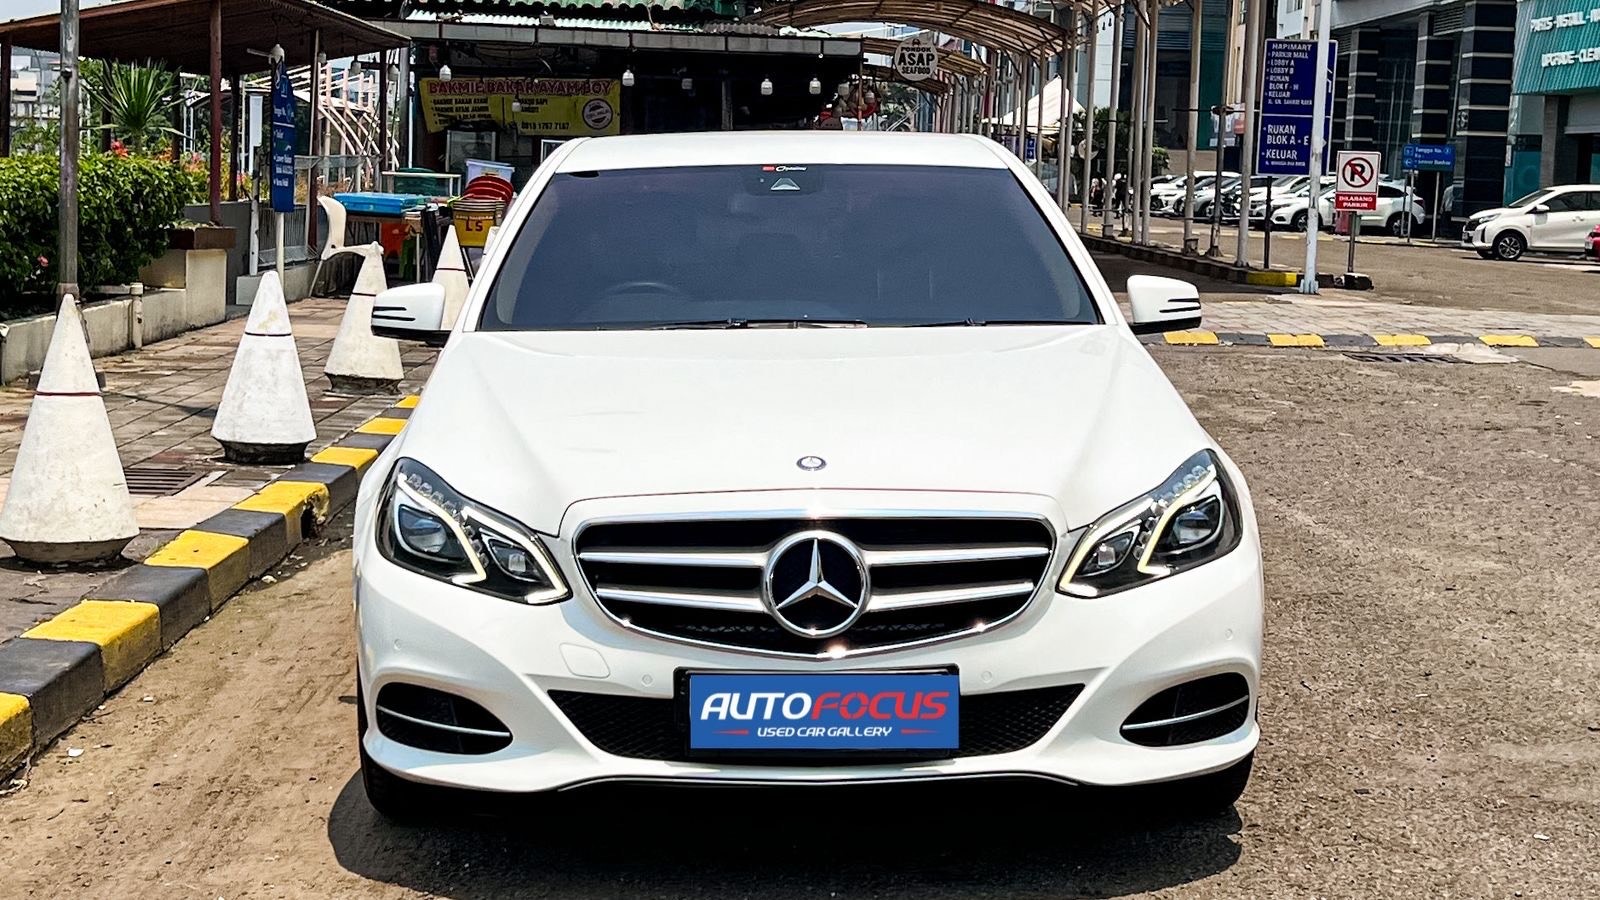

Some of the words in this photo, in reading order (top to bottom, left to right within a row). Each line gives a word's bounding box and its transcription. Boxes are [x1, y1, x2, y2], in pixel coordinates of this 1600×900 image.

[898, 53, 935, 66] ASAP
[1293, 51, 1309, 59] MALL
[901, 66, 931, 74] SEAFOOD
[428, 80, 485, 96] BAKMIE
[487, 80, 536, 96] BAKAR
[538, 80, 583, 96] AYAM
[1267, 124, 1296, 134] RUKAN
[1266, 135, 1288, 144] BLOK
[1289, 135, 1296, 145] A
[1303, 135, 1309, 145] E
[1265, 149, 1298, 159] KELUAR
